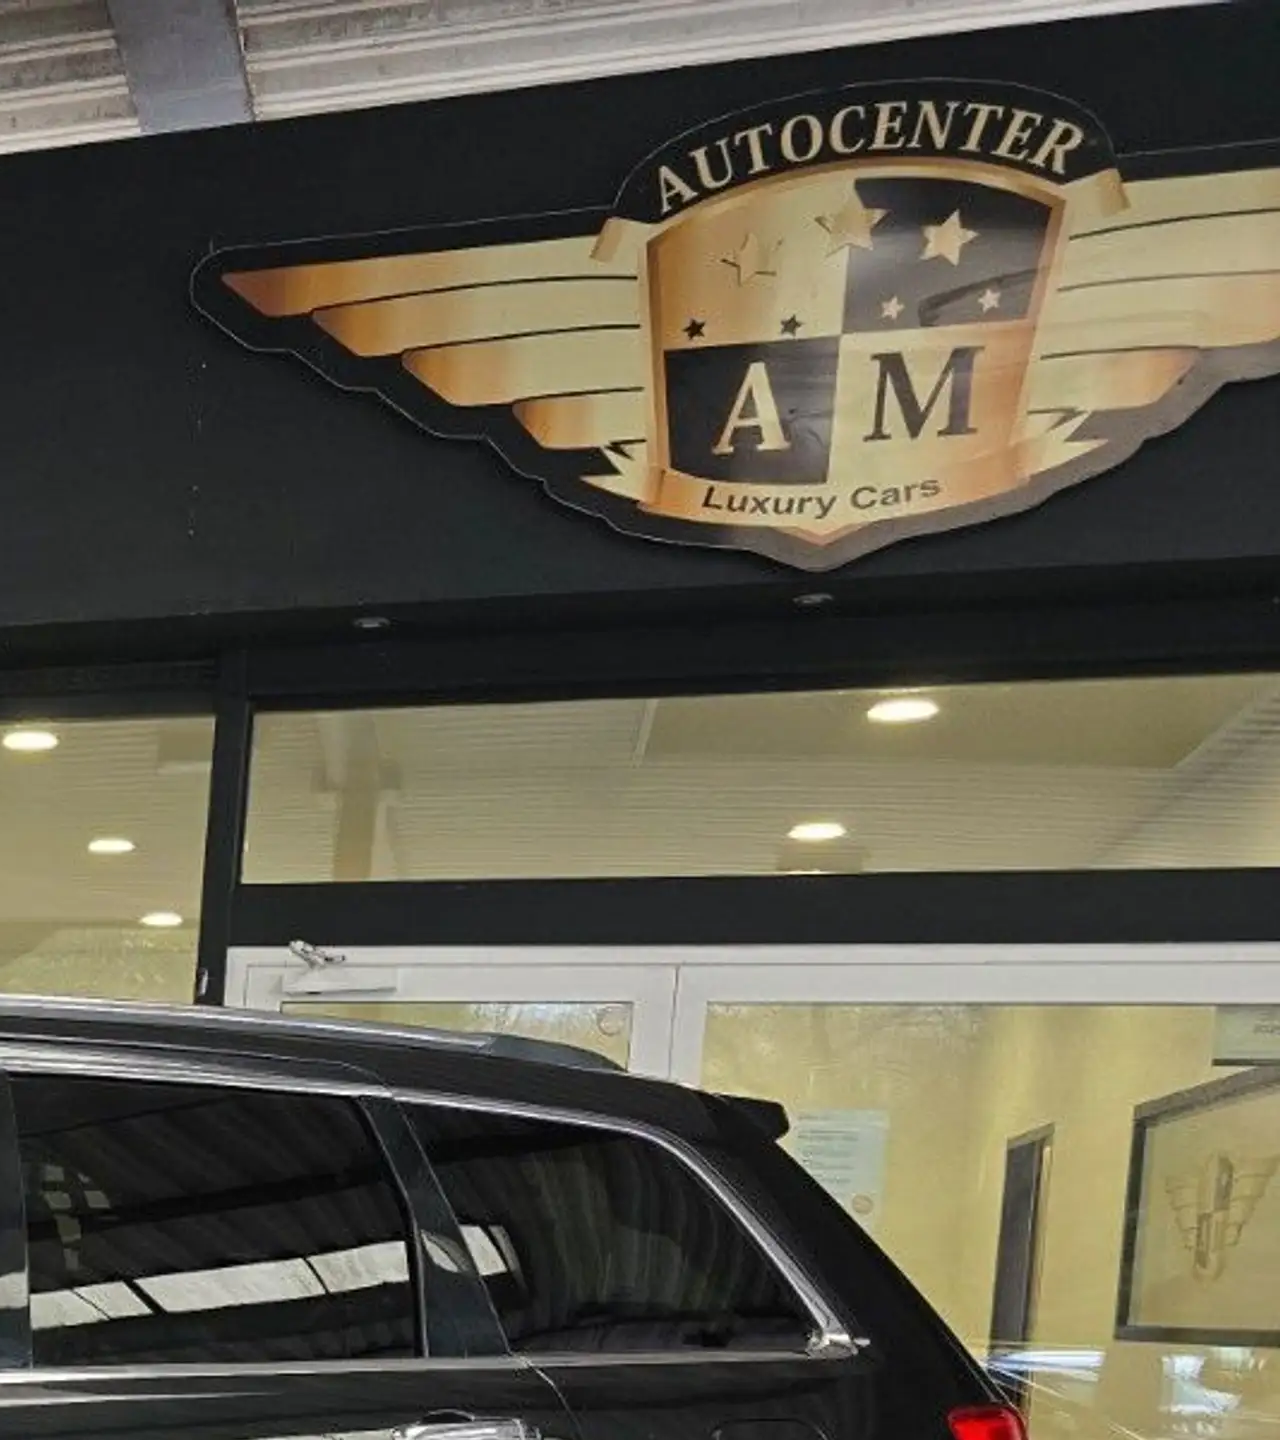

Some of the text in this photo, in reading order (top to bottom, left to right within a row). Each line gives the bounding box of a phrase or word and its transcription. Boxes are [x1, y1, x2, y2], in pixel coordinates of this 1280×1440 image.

[659, 101, 1084, 214] AUTOCENTER
[711, 346, 986, 456] A M
[701, 479, 941, 520] Luxury Cars
